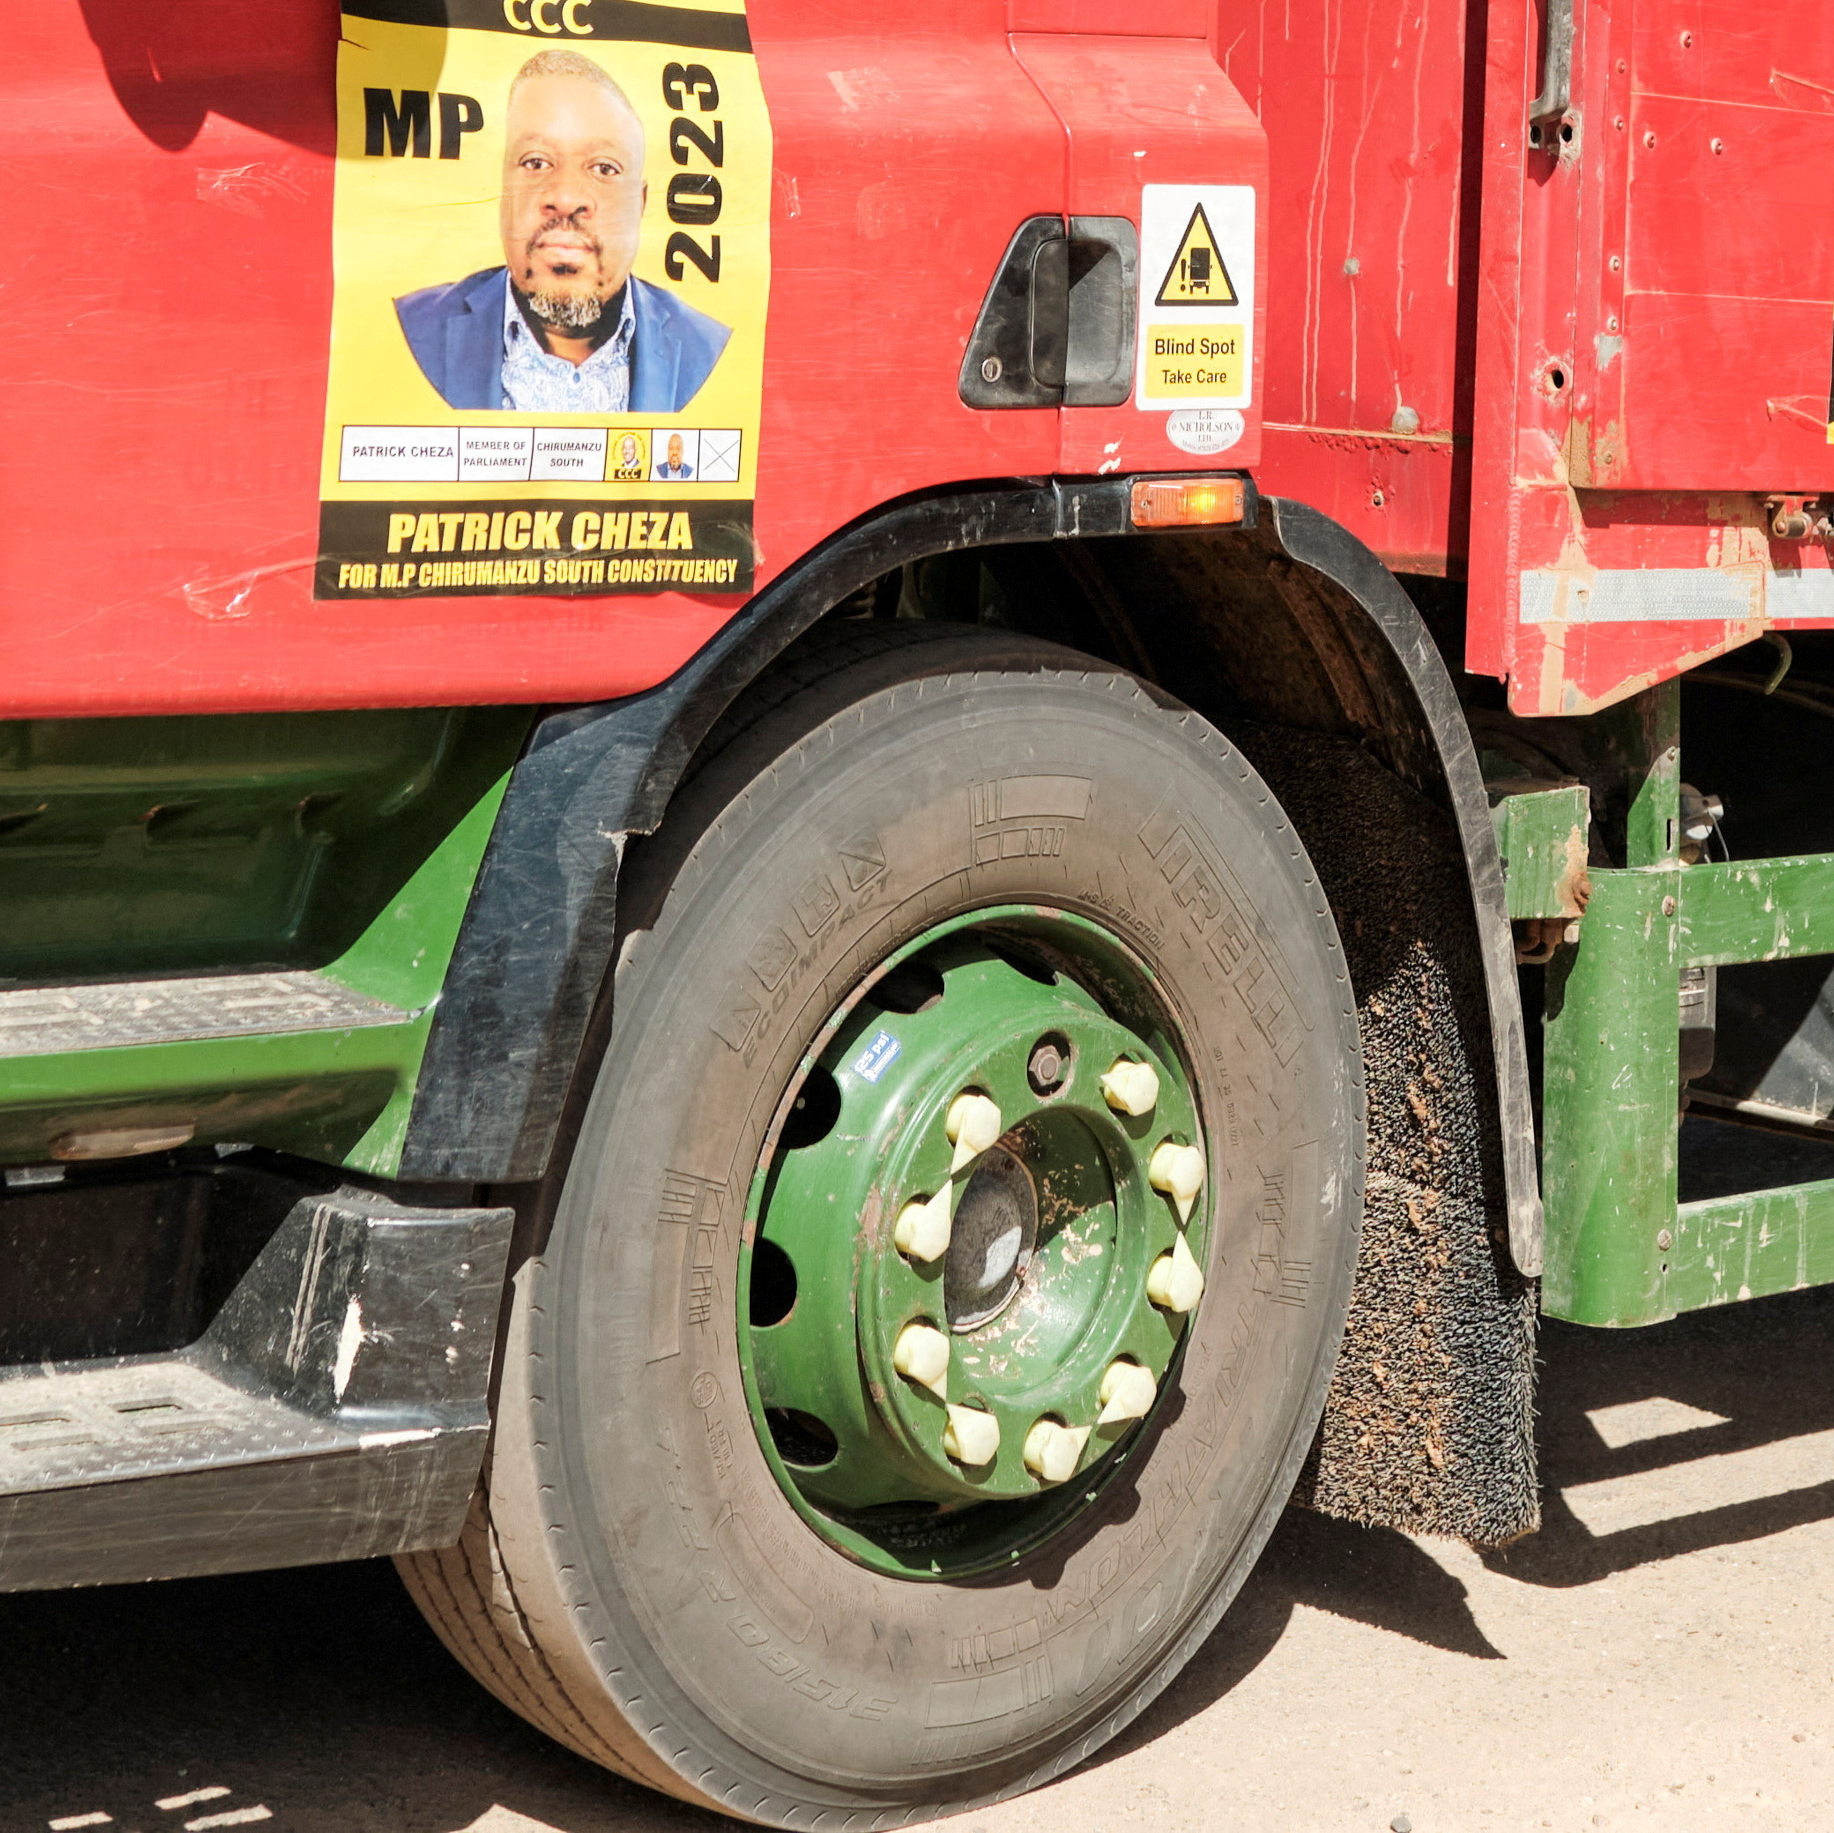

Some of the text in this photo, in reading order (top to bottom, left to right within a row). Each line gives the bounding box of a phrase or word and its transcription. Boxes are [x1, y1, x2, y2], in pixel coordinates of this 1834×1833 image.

[363, 86, 484, 160] MP
[663, 61, 724, 283] 2023
[1154, 338, 1235, 359] Blind Spot
[1162, 369, 1227, 384] Take Care
[1179, 422, 1233, 432] NICHOLSON
[353, 446, 454, 457] PATRICK CHEZA
[467, 442, 526, 451] MEMBER OF
[537, 442, 602, 452] CHIRUMANZU
[464, 457, 527, 467] PARLIAMENT
[550, 458, 583, 468] SOUTH
[617, 469, 639, 479] CCC
[387, 511, 693, 554] PATRICK CHEZA
[338, 559, 738, 589] FOR M.P CHIRUMANZU SOUTH CONSTITUENCY
